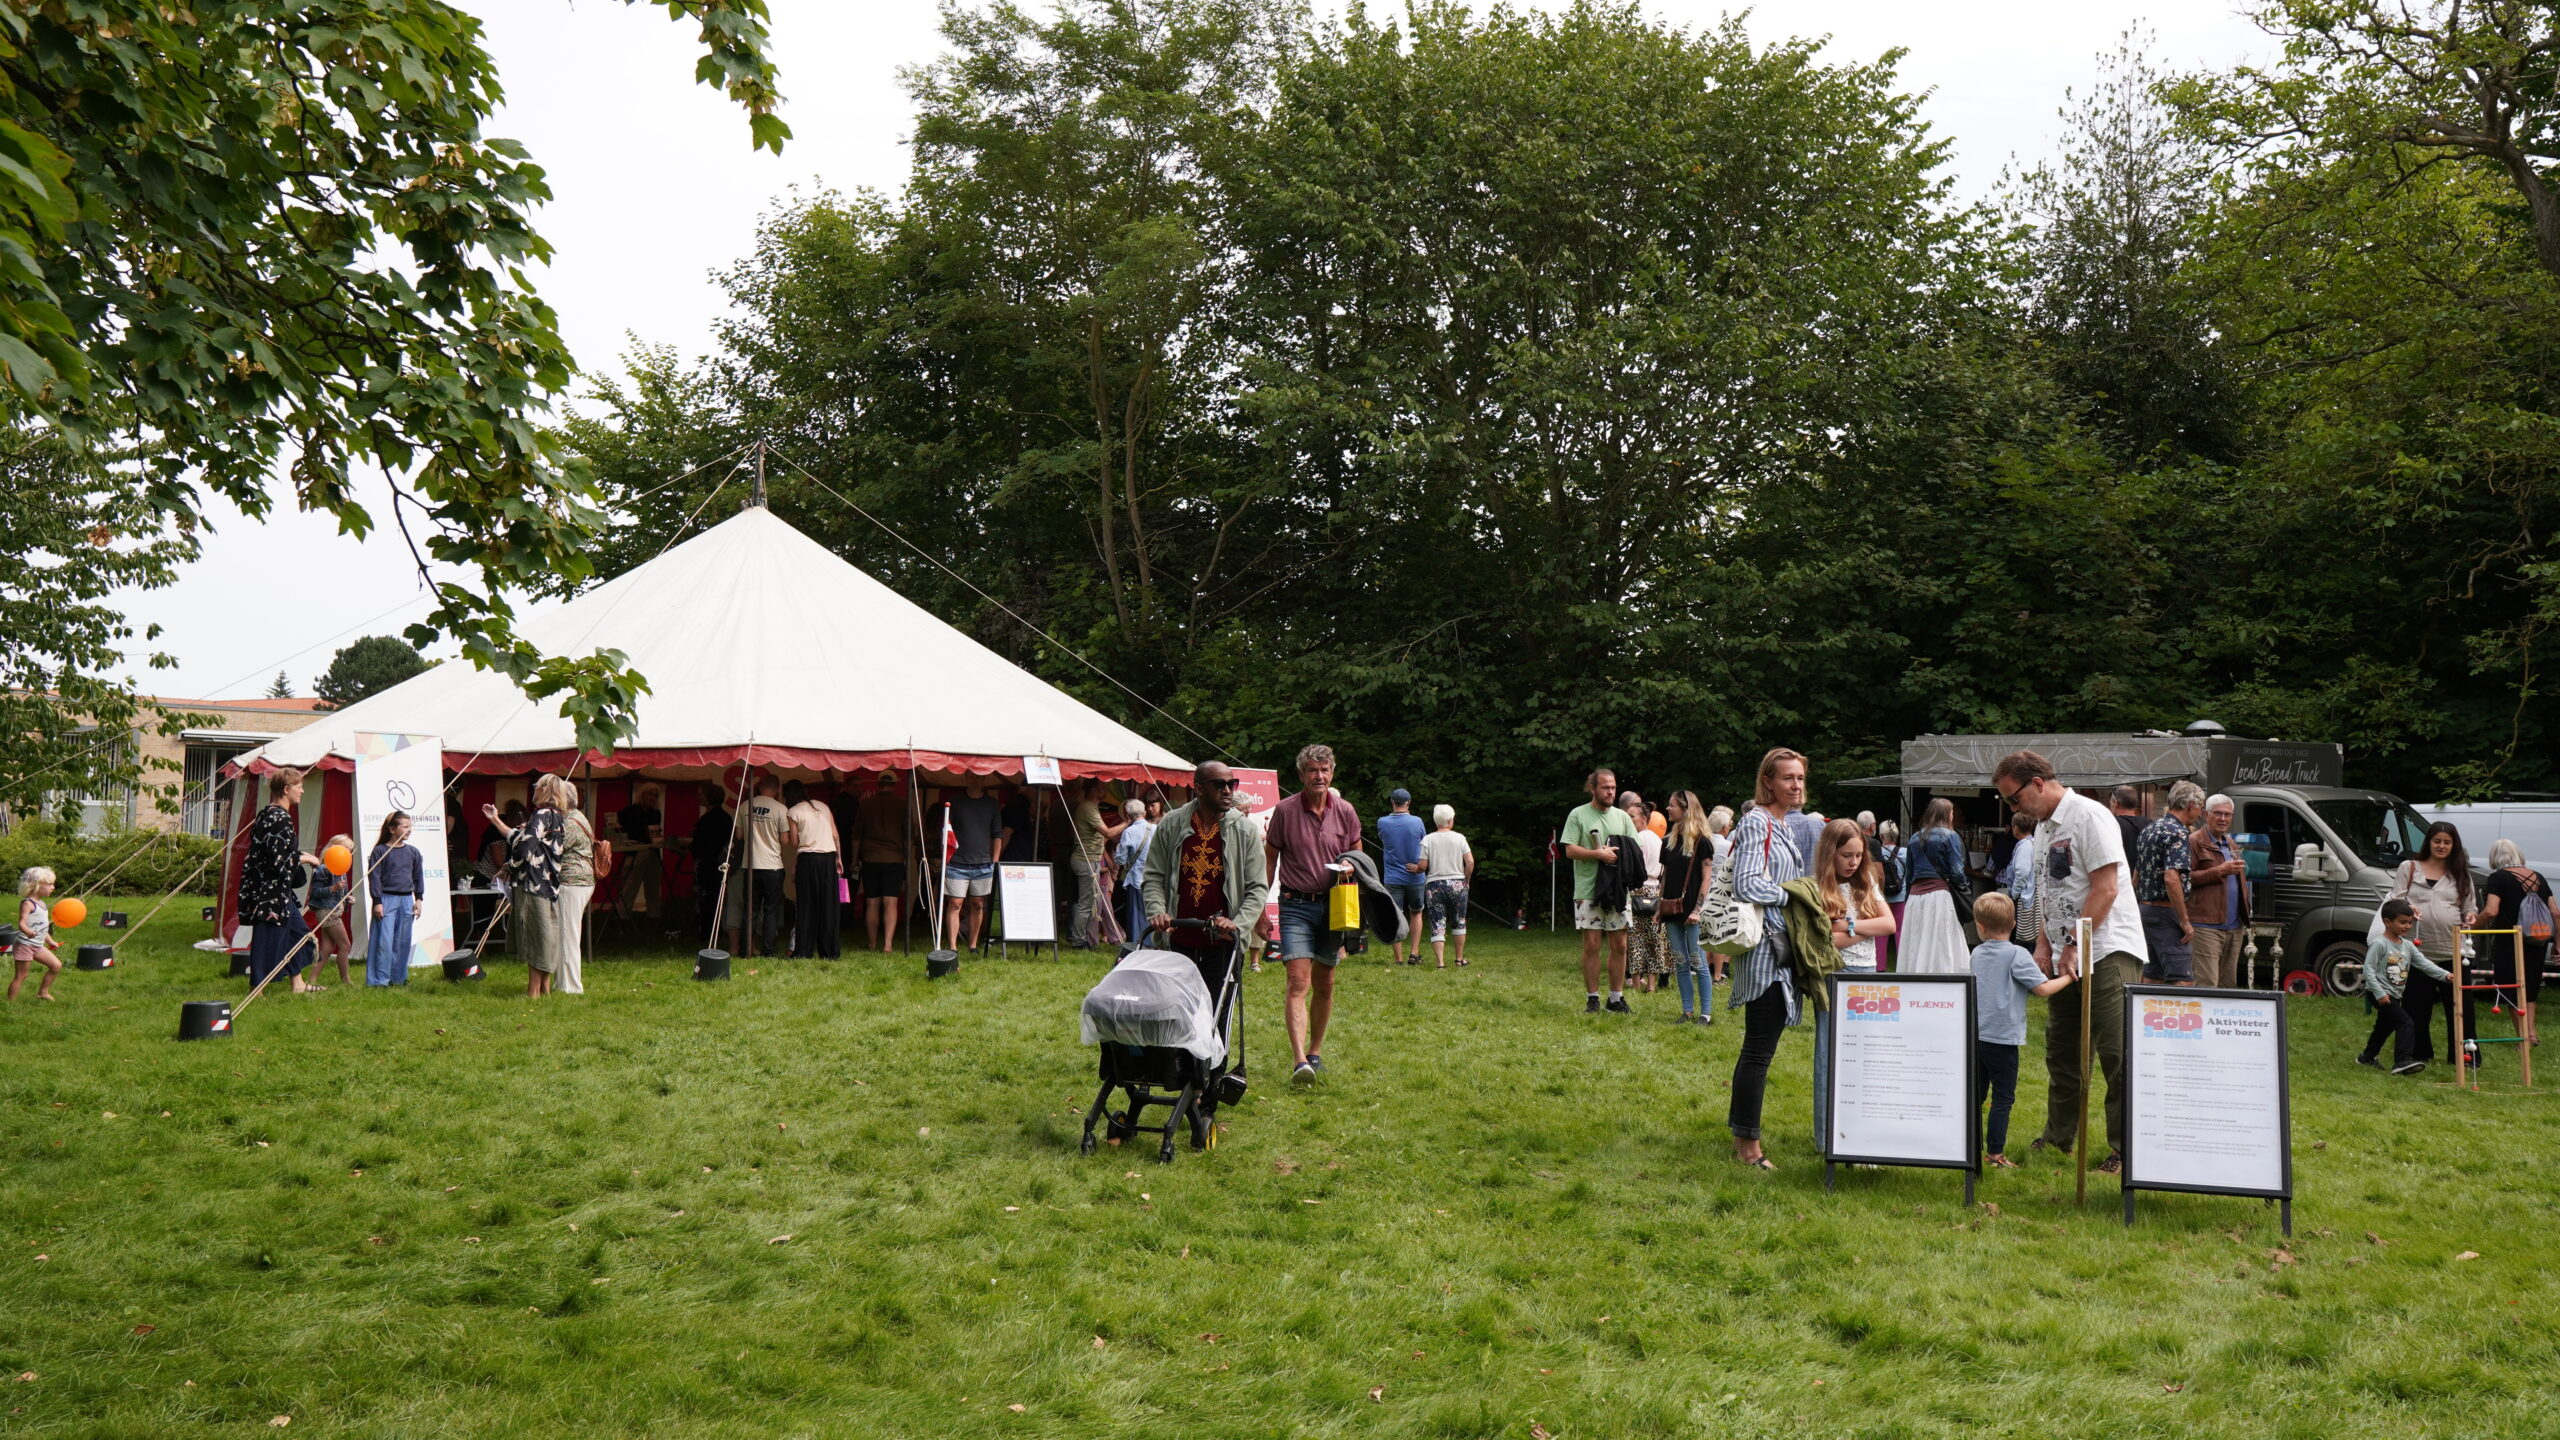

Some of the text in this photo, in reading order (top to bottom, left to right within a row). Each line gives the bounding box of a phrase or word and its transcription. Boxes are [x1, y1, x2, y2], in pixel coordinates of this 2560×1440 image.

[2232, 756, 2320, 784] Local Bread Truck
[1910, 1001, 1955, 1009] PLÆNEN
[2213, 1008, 2264, 1017] PLÆNEN
[2207, 1018, 2271, 1028] Aktiviteter
[2215, 1028, 2262, 1037] for børn
